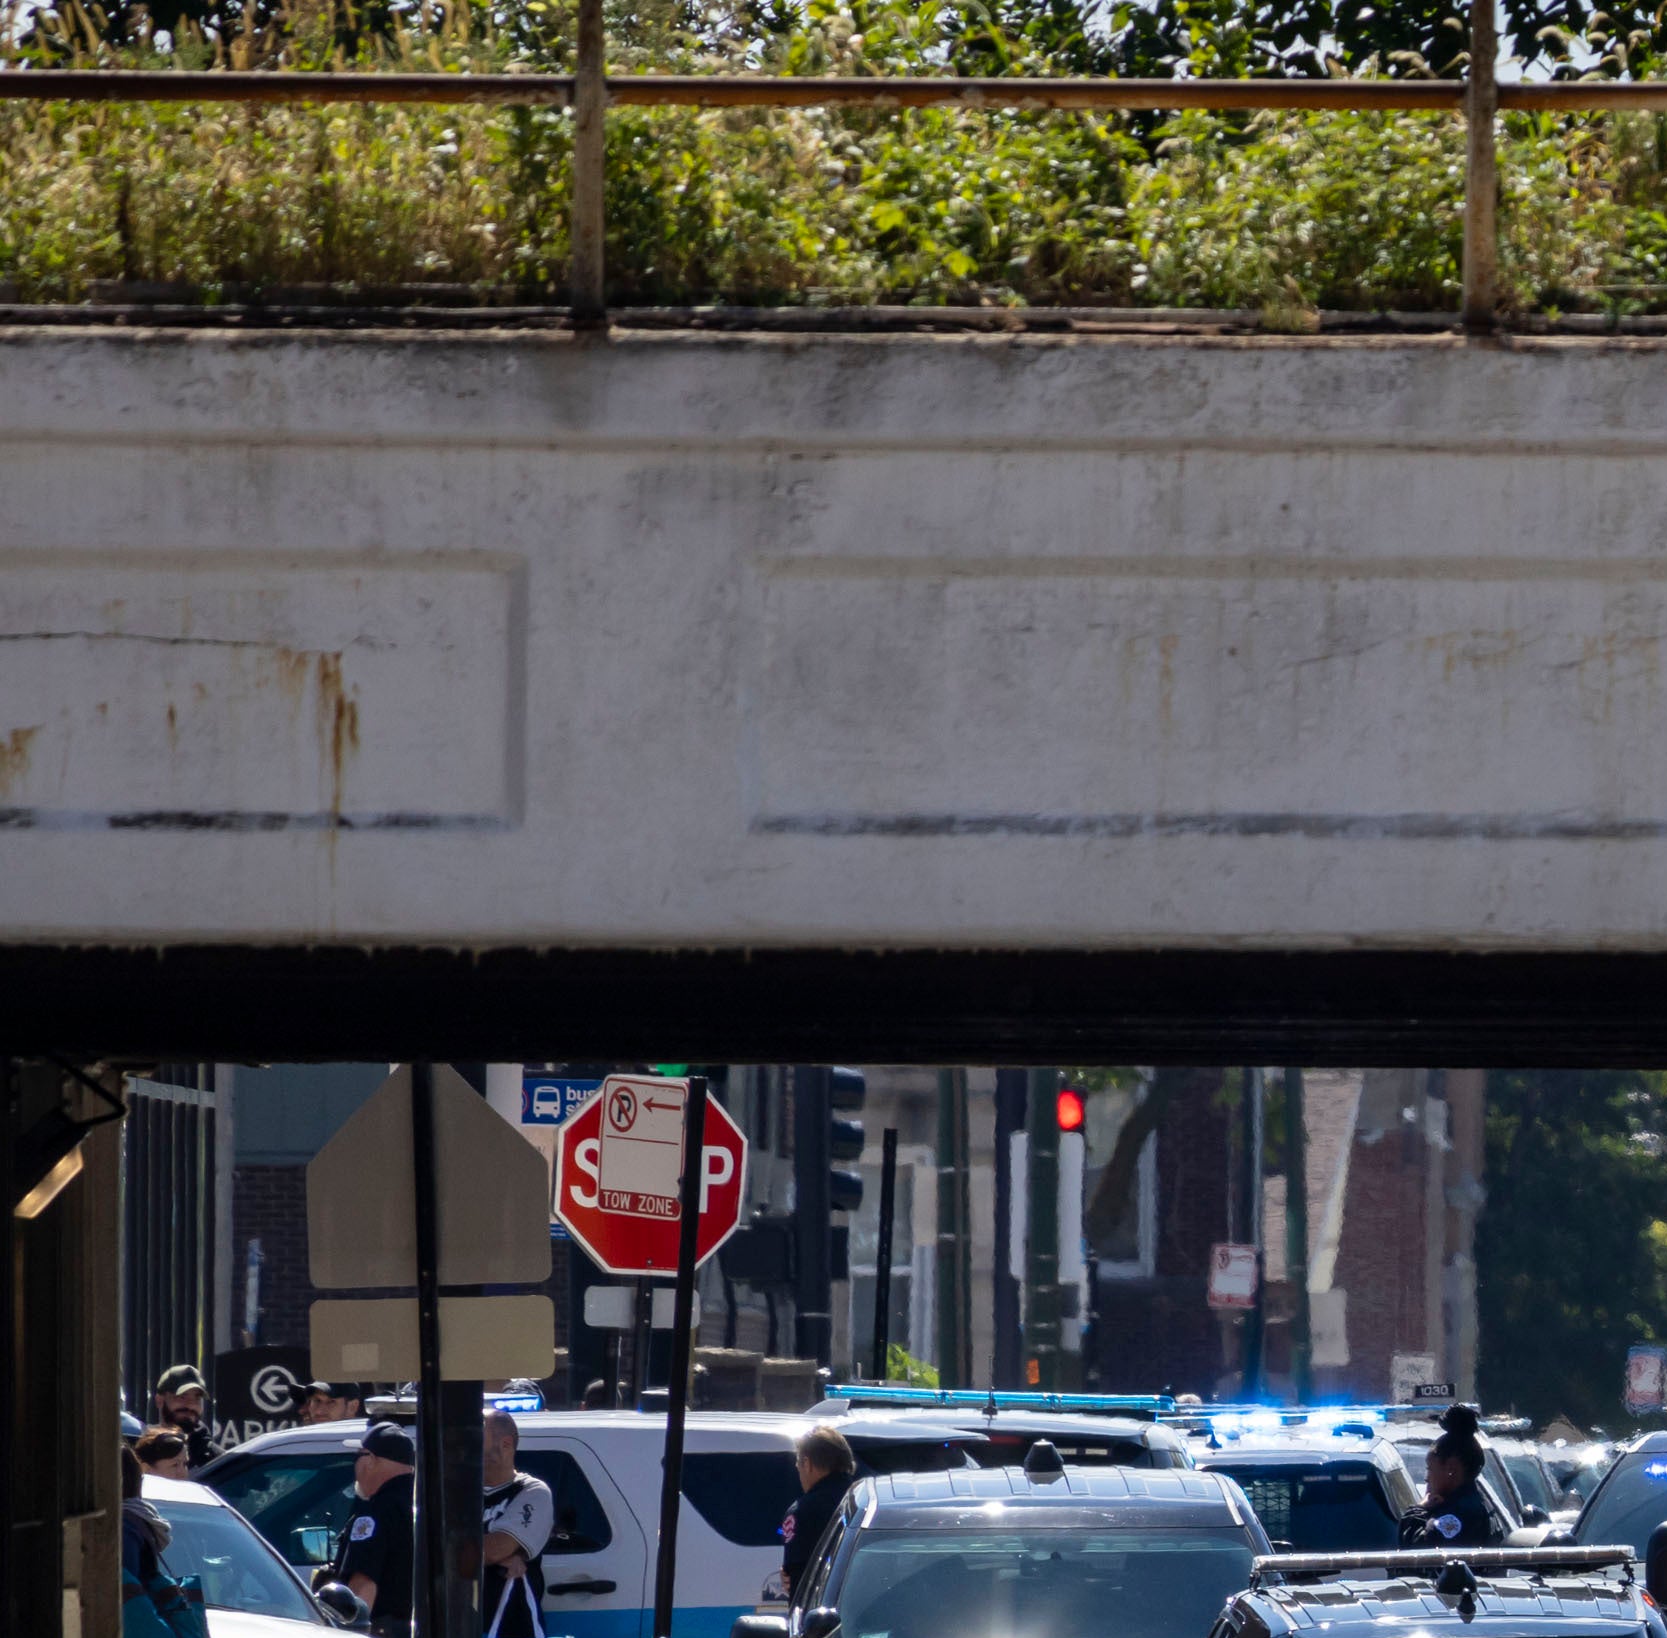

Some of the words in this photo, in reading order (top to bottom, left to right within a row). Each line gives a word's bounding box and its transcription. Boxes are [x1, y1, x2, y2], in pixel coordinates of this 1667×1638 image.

[570, 1138, 734, 1214] SP
[603, 1191, 635, 1210] TOW
[638, 1195, 673, 1216] ZONE
